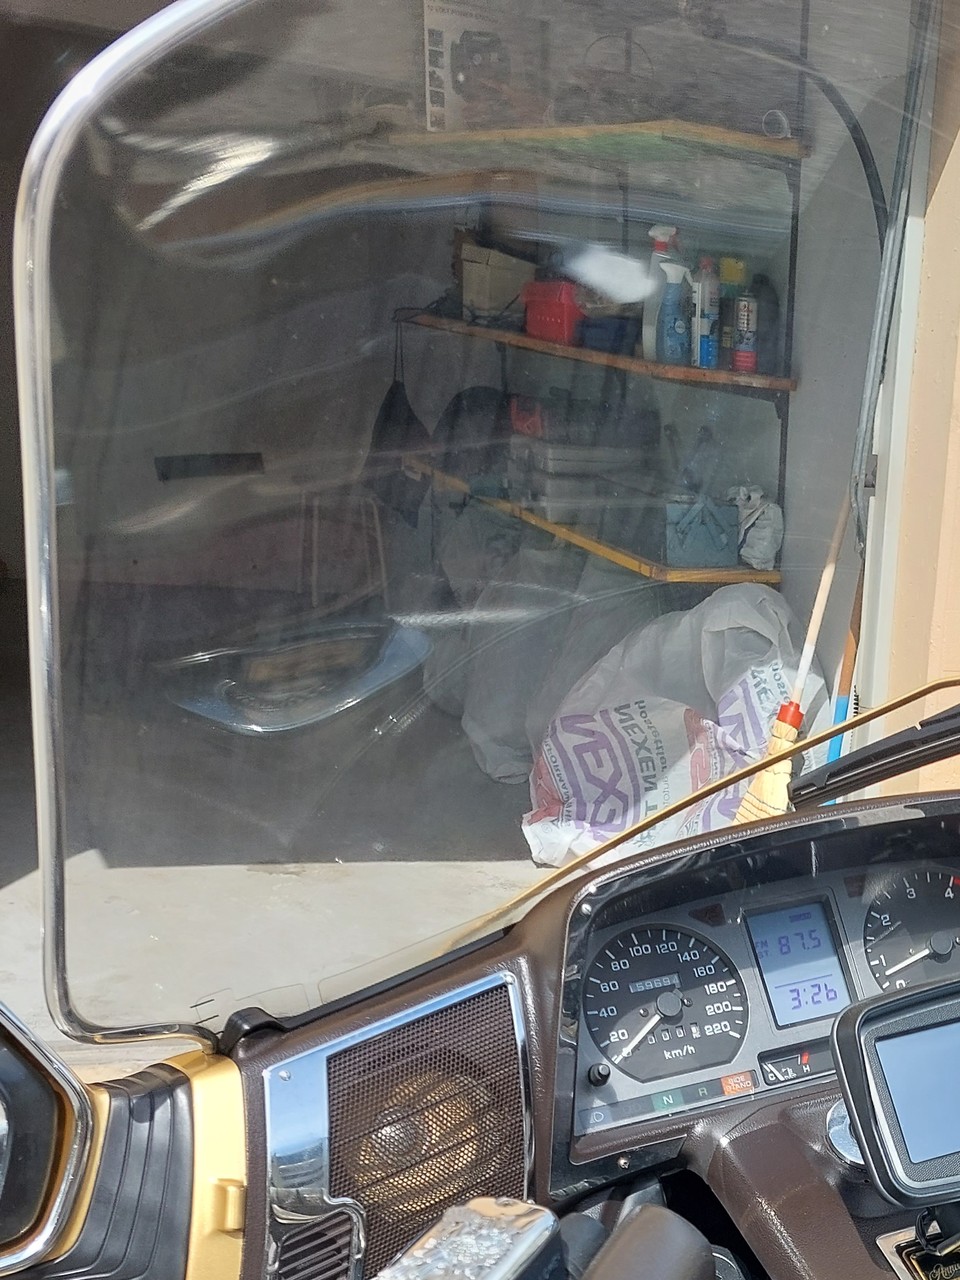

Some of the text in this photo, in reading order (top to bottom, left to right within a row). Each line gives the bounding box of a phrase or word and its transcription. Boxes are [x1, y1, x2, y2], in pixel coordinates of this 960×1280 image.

[906, 888, 916, 899] 3
[945, 888, 954, 899] 4
[881, 915, 891, 926] 2
[655, 941, 678, 954] 120
[778, 929, 821, 955] 87.5
[629, 944, 651, 958] 100
[678, 950, 700, 963] 140
[611, 959, 630, 972] 80
[880, 955, 887, 967] 1
[693, 965, 715, 978] 160
[600, 984, 620, 993] 60
[704, 981, 727, 995] 180
[789, 983, 837, 1010] 3:26
[599, 1006, 617, 1018] 40
[705, 1001, 732, 1016] 200
[704, 1021, 731, 1036] 220
[609, 1029, 629, 1043] 20
[664, 1045, 696, 1060] km/h
[803, 1065, 811, 1073] H
[699, 1088, 708, 1097] R
[663, 1094, 673, 1105] N
